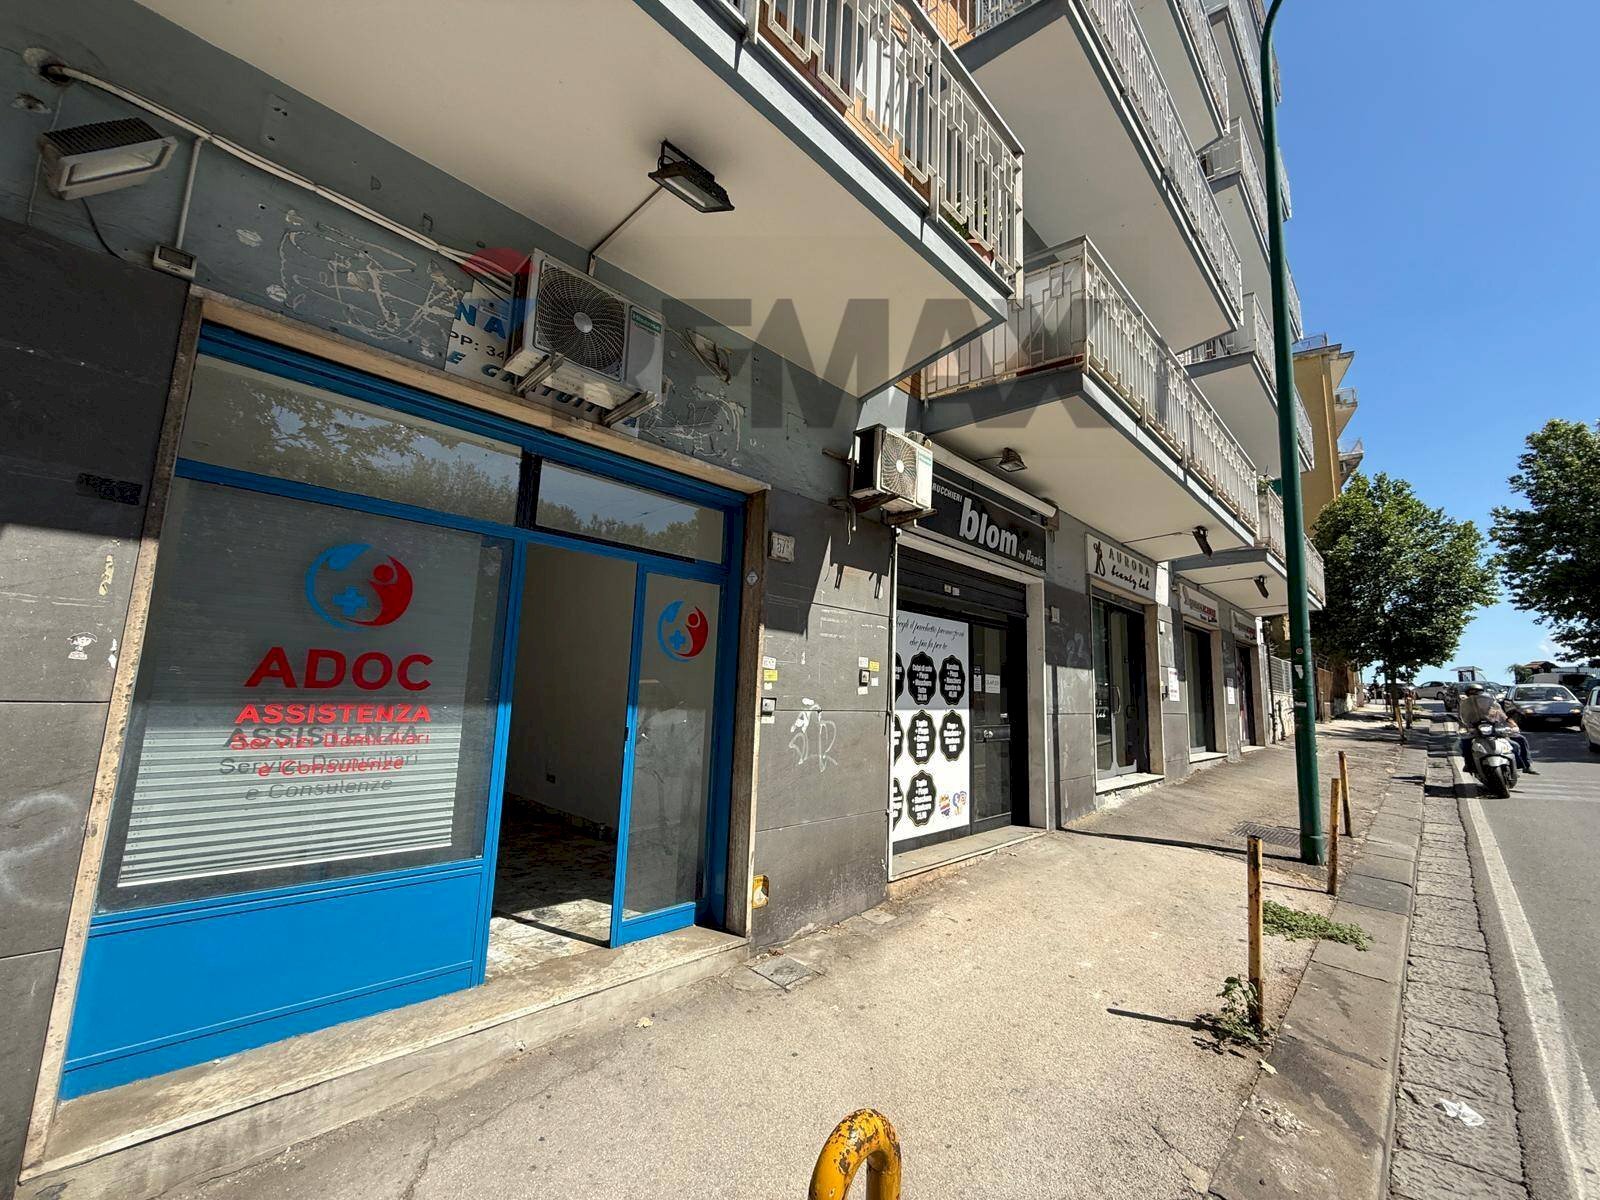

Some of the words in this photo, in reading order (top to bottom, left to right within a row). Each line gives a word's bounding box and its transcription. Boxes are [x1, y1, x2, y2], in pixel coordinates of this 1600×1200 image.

[959, 497, 1018, 557] blom
[1109, 548, 1150, 578] AURORA
[1111, 565, 1137, 590] beauty
[1139, 578, 1150, 591] lab
[244, 646, 434, 691] ADOC
[235, 703, 432, 724] ASSISTENZA
[230, 733, 315, 750] Servizi
[258, 763, 272, 777] e
[280, 758, 404, 776] Consulenze
